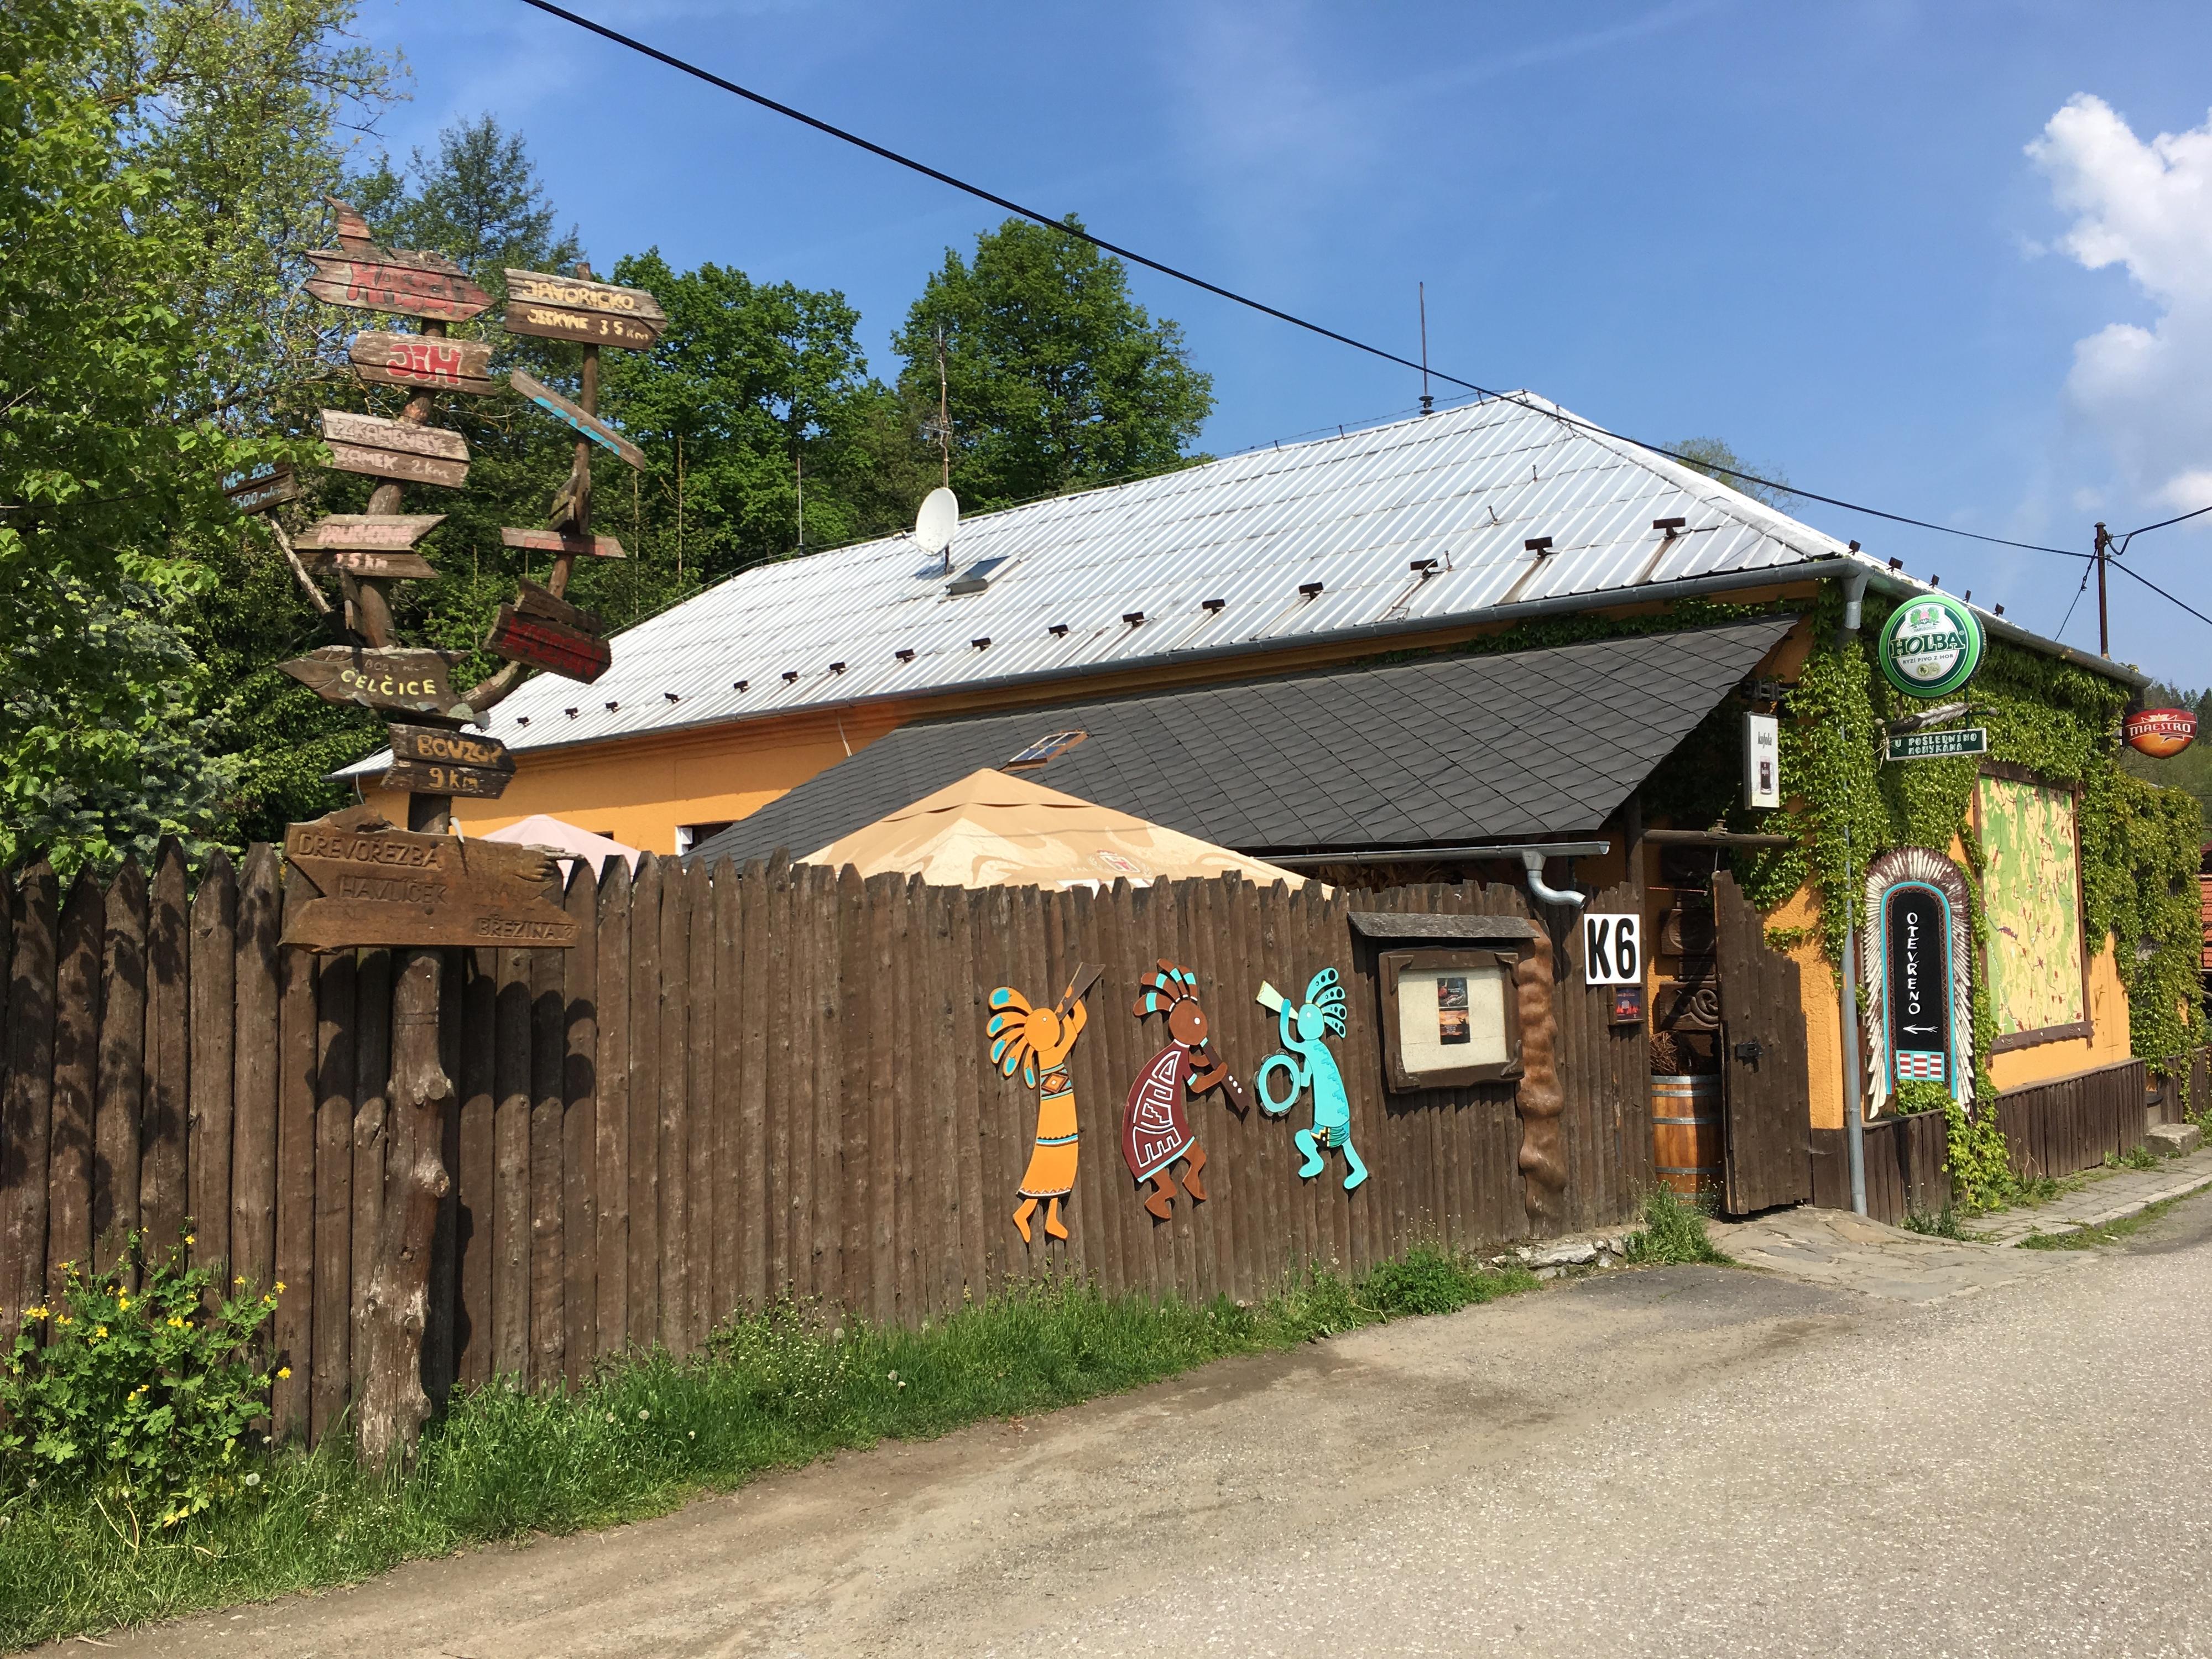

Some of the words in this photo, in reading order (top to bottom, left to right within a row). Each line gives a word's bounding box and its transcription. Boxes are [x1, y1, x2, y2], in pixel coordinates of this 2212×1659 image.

[411, 459, 422, 473] 2
[425, 461, 449, 478] km
[1890, 631, 1965, 658] HOLBA
[2130, 723, 2190, 737] MAESTRO
[1757, 732, 1772, 748] kofola
[1895, 739, 1902, 747] U
[1908, 733, 1977, 746] POSLEDNÍHO
[1908, 742, 1963, 755] MOHYKÁNA
[429, 768, 442, 789] 9
[450, 770, 478, 789] km
[1587, 917, 1636, 979] K6
